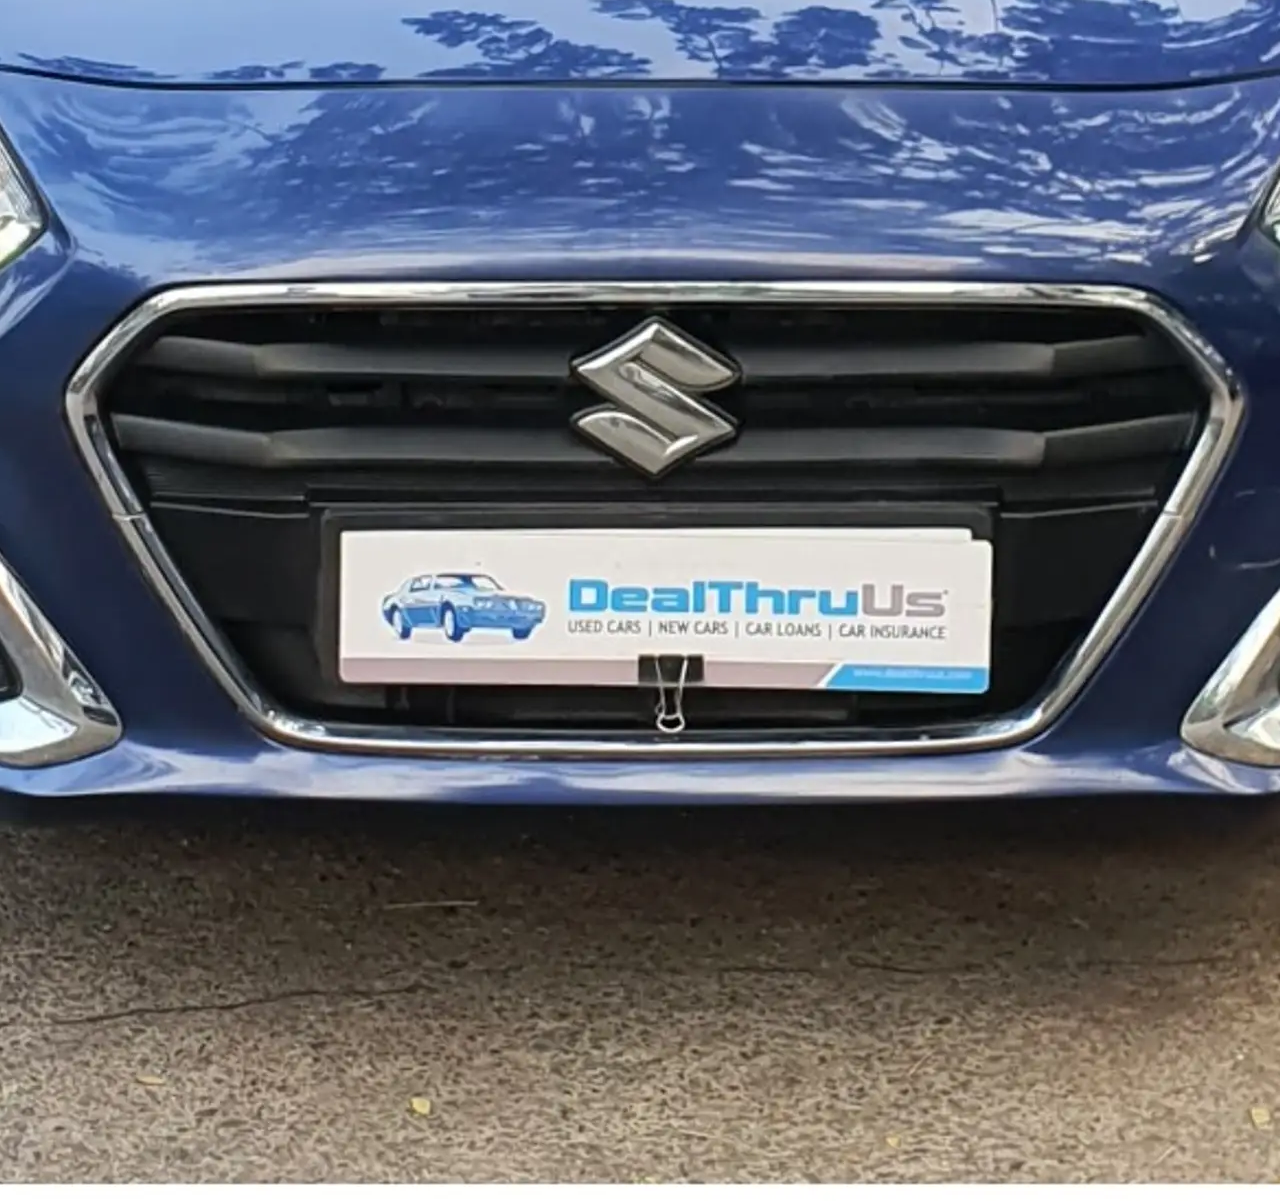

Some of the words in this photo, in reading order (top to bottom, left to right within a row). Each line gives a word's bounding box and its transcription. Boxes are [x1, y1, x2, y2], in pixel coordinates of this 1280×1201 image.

[569, 578, 946, 617] DealThruUs
[568, 619, 604, 634] USED
[606, 620, 642, 634] CARS
[658, 620, 690, 635] NEW
[693, 621, 729, 636] CARS
[744, 621, 773, 636] CAR
[776, 622, 823, 638] LOANS
[838, 623, 866, 638] CAR
[869, 625, 946, 640] INSURANCE
